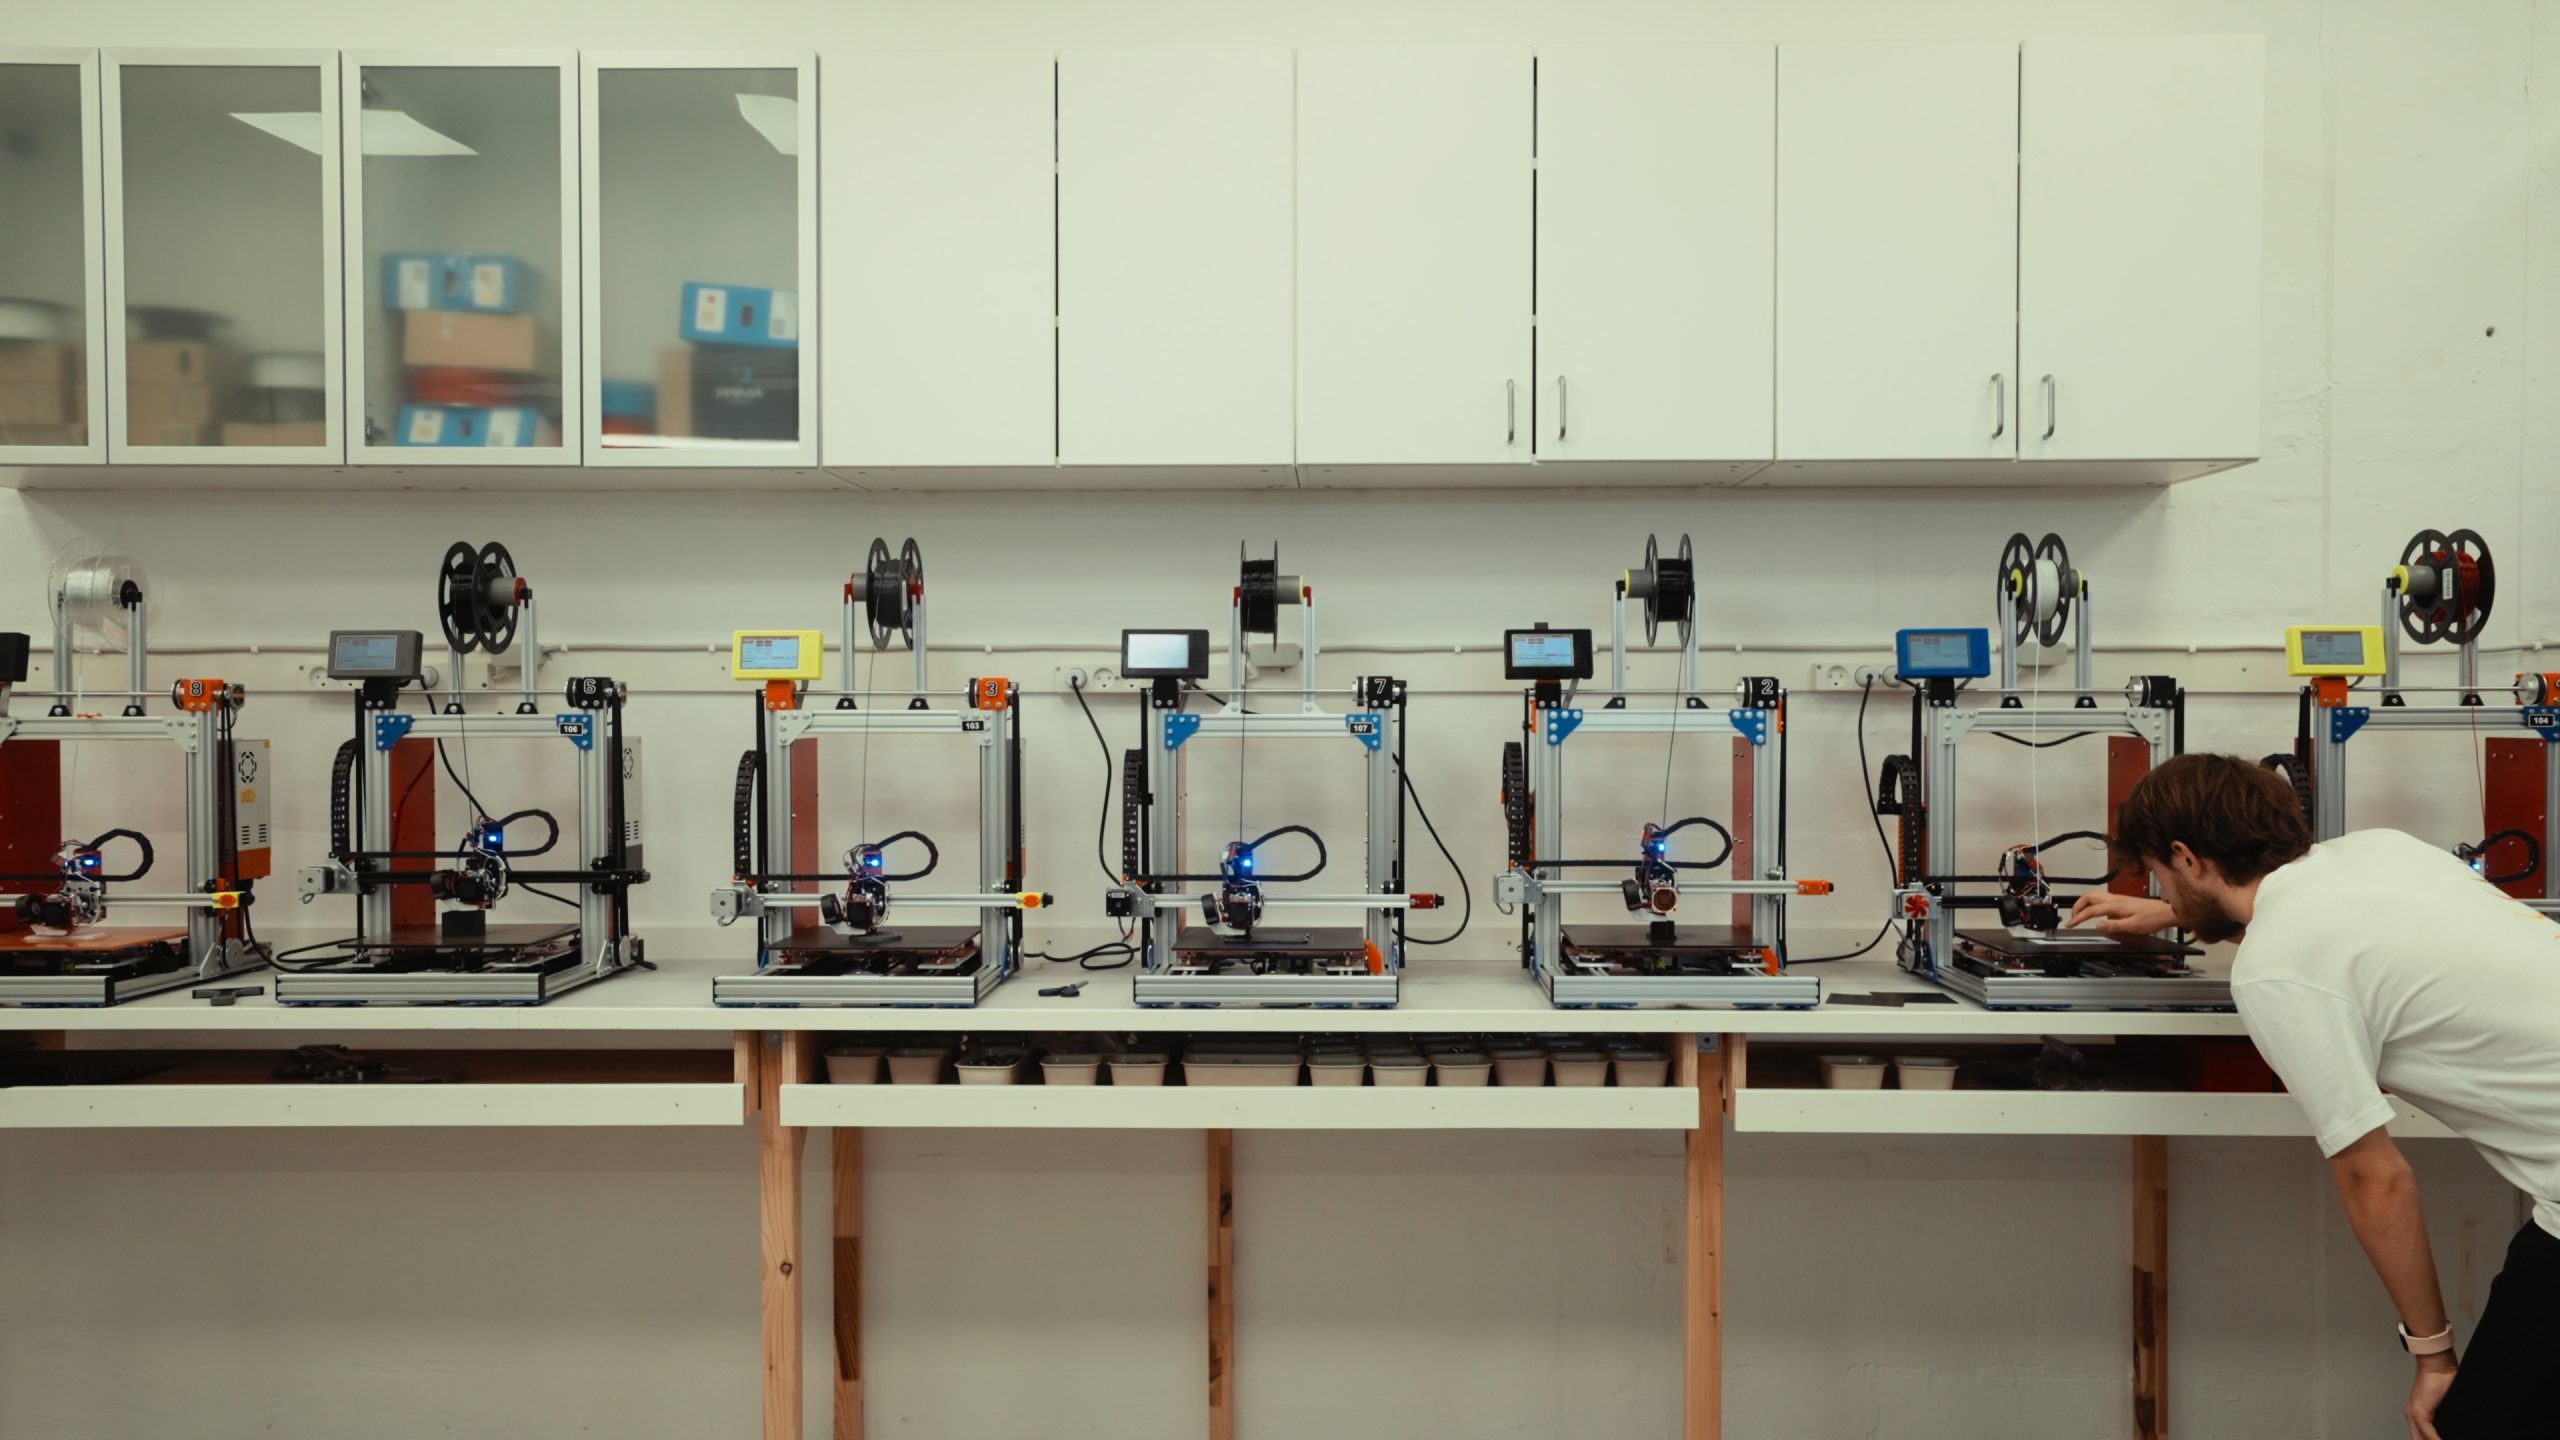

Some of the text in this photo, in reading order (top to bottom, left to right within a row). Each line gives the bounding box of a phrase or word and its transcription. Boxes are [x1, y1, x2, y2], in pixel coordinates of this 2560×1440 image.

[190, 681, 202, 697] 8
[584, 679, 596, 694] 6
[985, 681, 998, 697] 3
[1374, 679, 1386, 694] 7
[1761, 679, 1773, 694] 2
[965, 722, 980, 730] 103
[1353, 724, 1368, 732] 107
[2533, 716, 2549, 725] 104
[563, 725, 578, 733] 106
